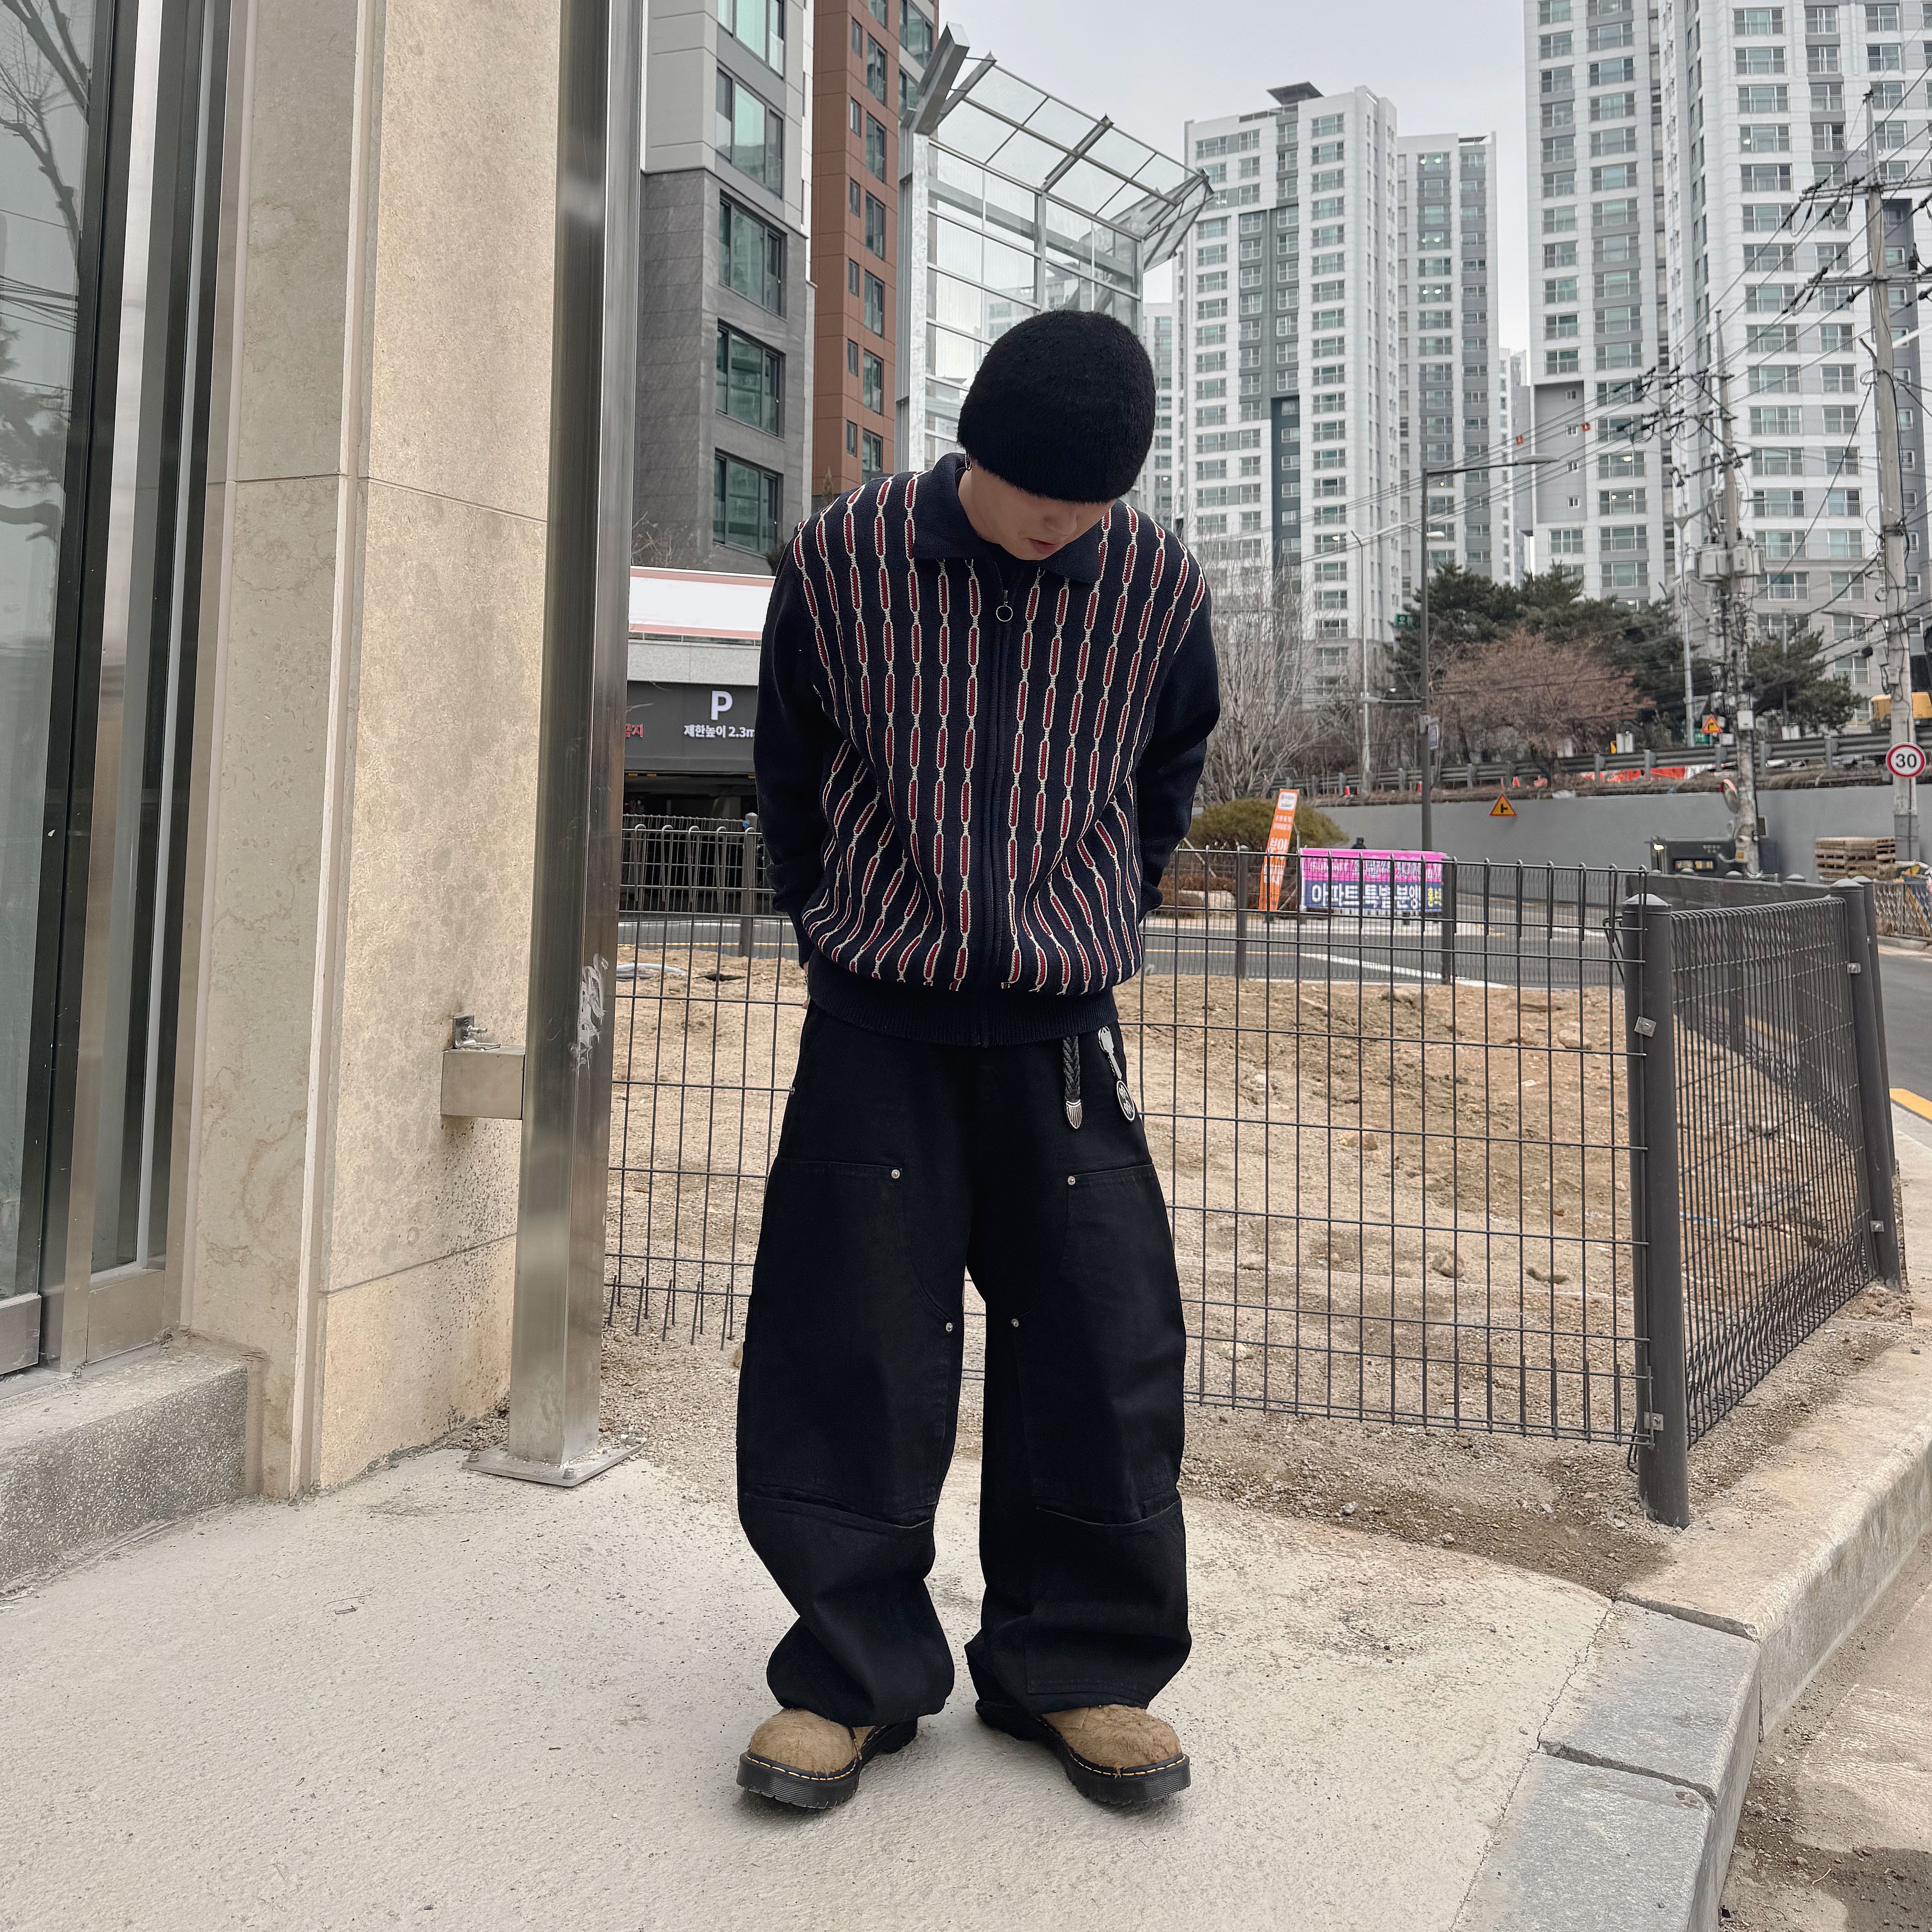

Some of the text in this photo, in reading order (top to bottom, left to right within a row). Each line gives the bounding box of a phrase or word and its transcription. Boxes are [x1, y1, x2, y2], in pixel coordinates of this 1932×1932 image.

[711, 690, 733, 720] P
[684, 724, 726, 738] 제한높이
[1895, 754, 1917, 768] 30
